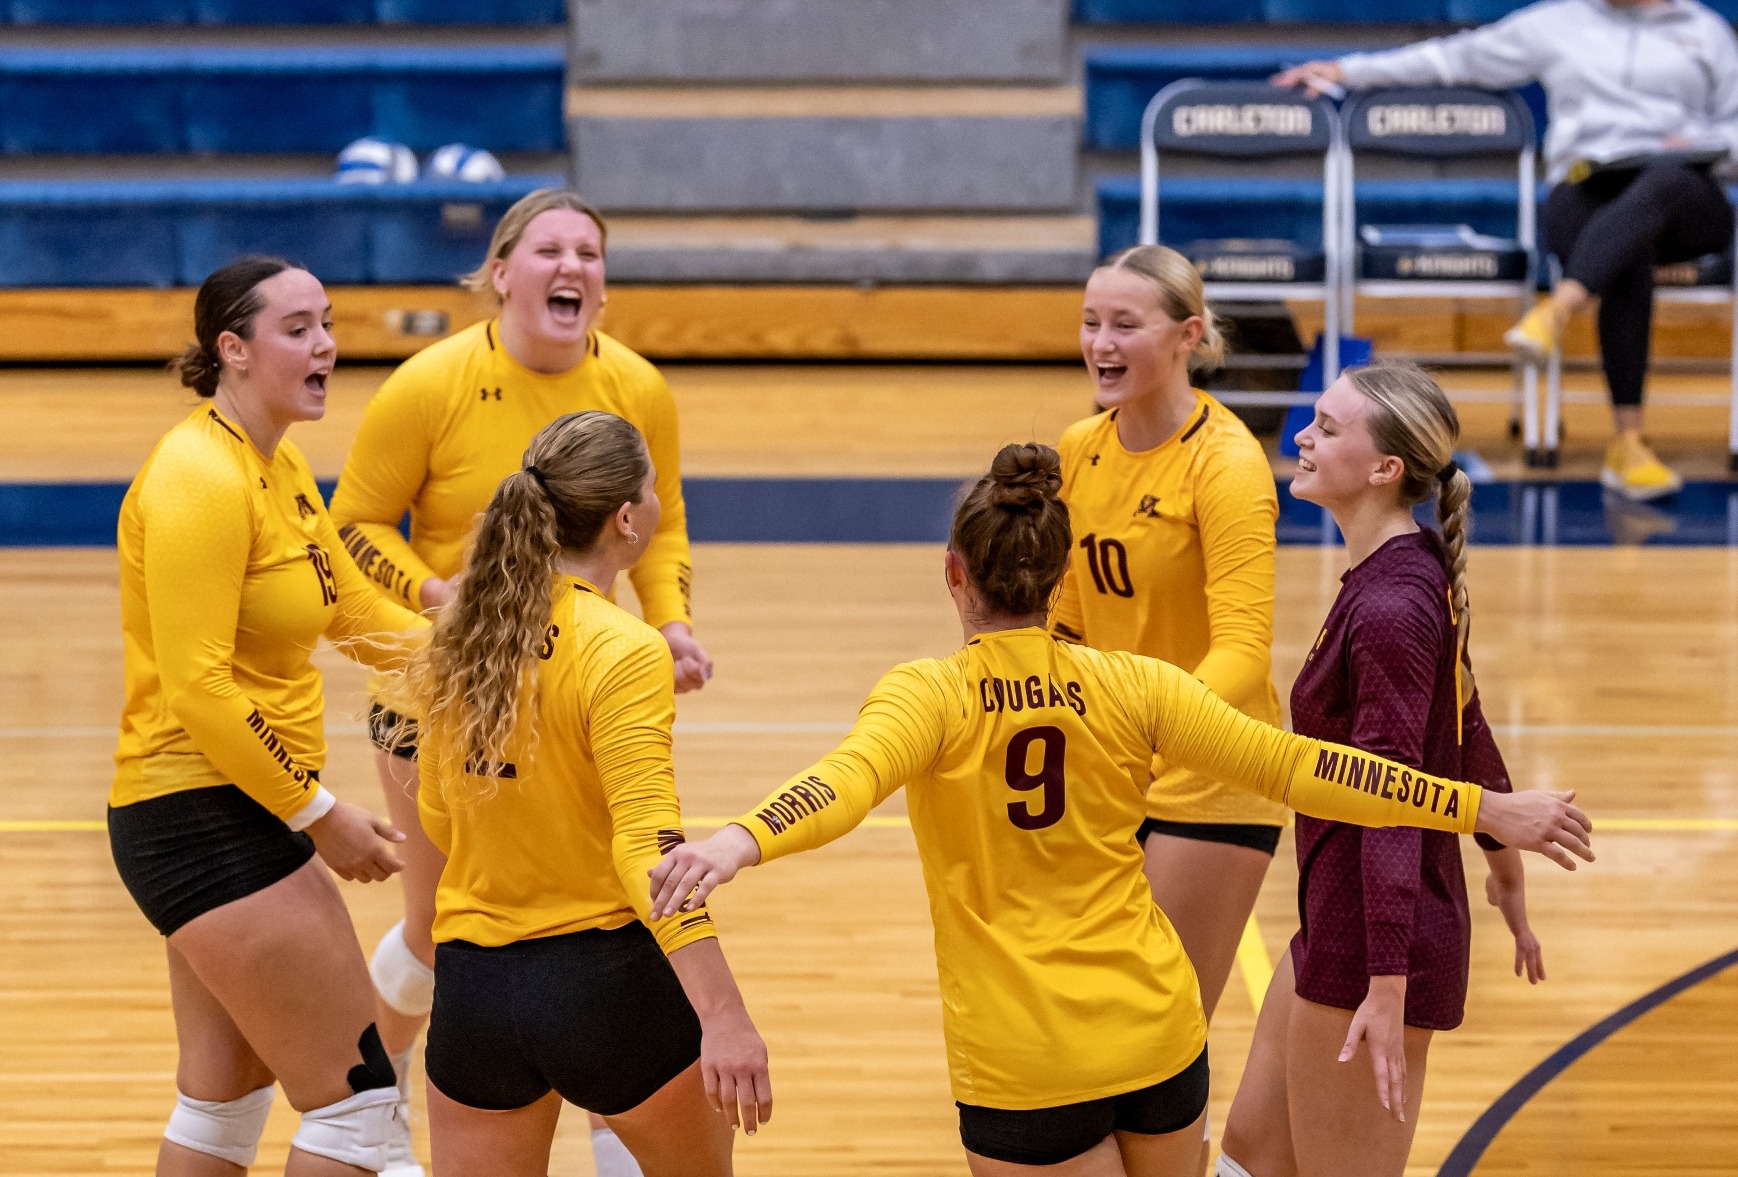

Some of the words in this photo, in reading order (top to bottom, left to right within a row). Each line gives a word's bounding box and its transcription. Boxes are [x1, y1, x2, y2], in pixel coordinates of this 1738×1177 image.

[1173, 105, 1312, 136] CARLETON
[1367, 104, 1506, 136] CARLETON
[1080, 532, 1135, 598] 10
[755, 775, 837, 836] MORRIS
[1005, 725, 1066, 831] 9
[1313, 748, 1459, 819] MINNESOTA
